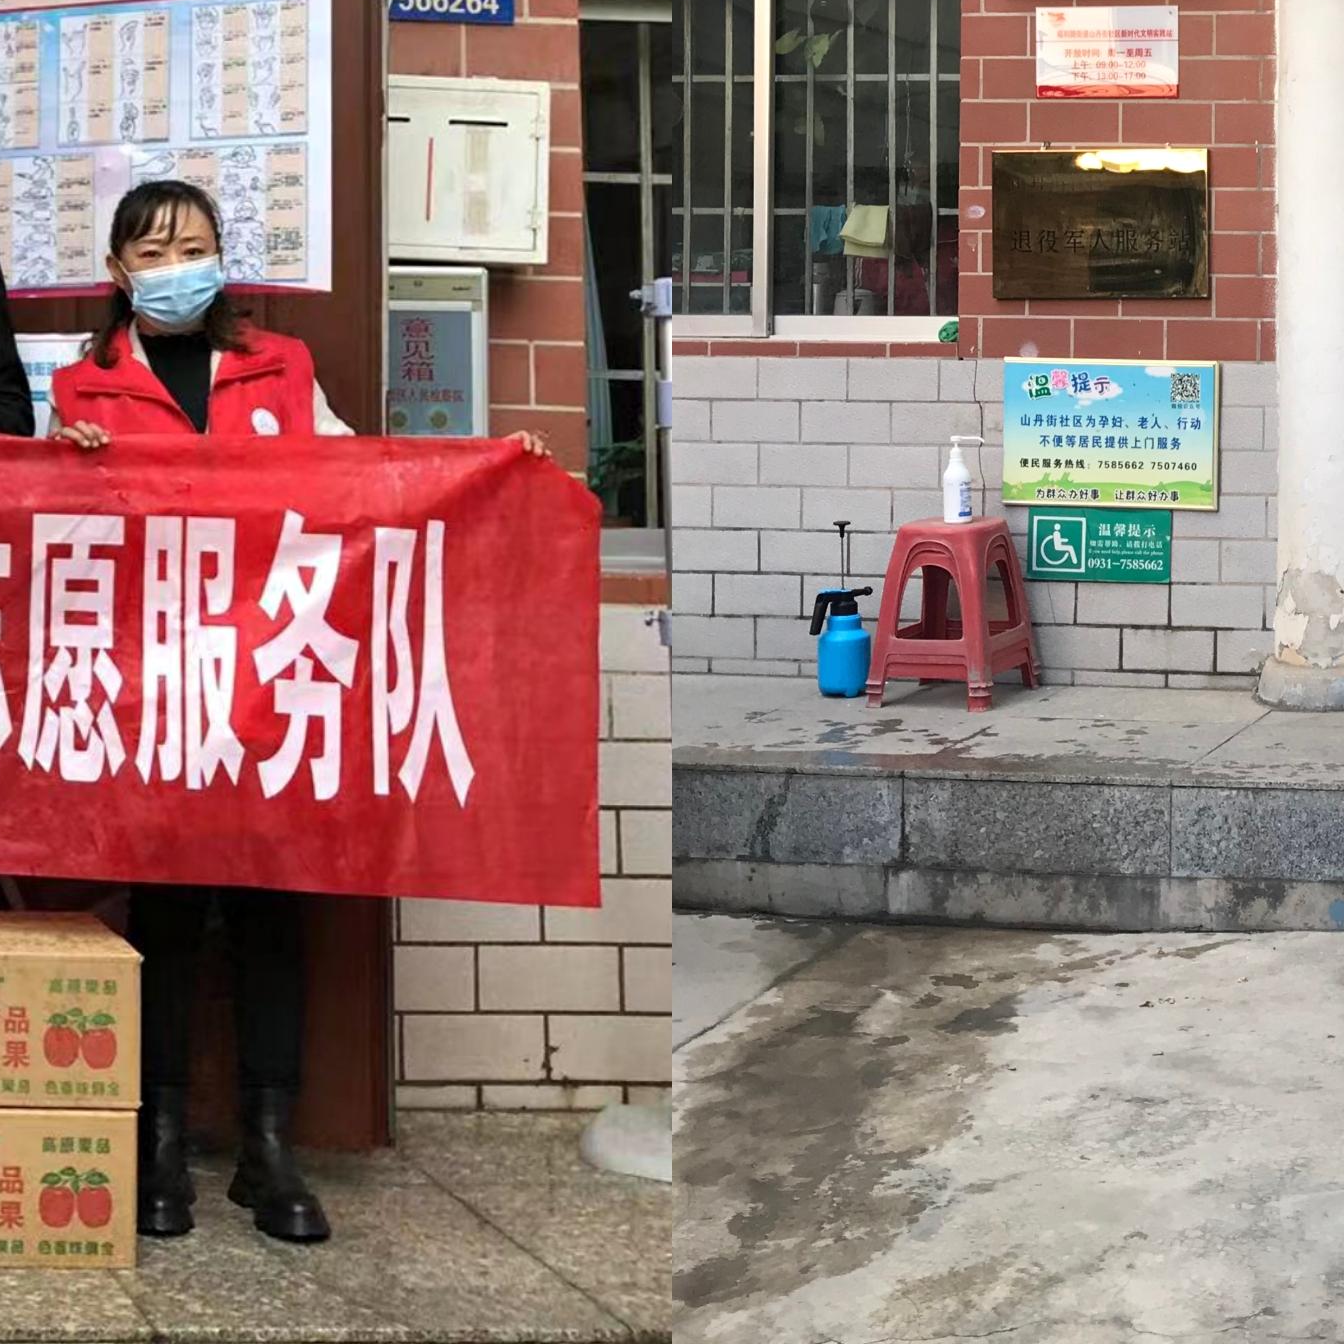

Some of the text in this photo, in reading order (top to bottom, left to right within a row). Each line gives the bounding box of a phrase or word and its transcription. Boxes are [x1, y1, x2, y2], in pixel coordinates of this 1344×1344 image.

[1009, 228, 1193, 255] 退役军人服务站
[401, 316, 435, 381] 意见箱
[1028, 368, 1111, 399] 温馨提示
[1019, 414, 1202, 431] 山丹街社区为孕妇、老人、行动
[1039, 434, 1182, 451] 不便等居民提供上门服务
[1097, 460, 1145, 470] 7585662
[1150, 461, 1198, 471] 7507460
[1035, 488, 1180, 502] 为群众办好事 让群众好办事
[1098, 523, 1156, 538] 温馨提示
